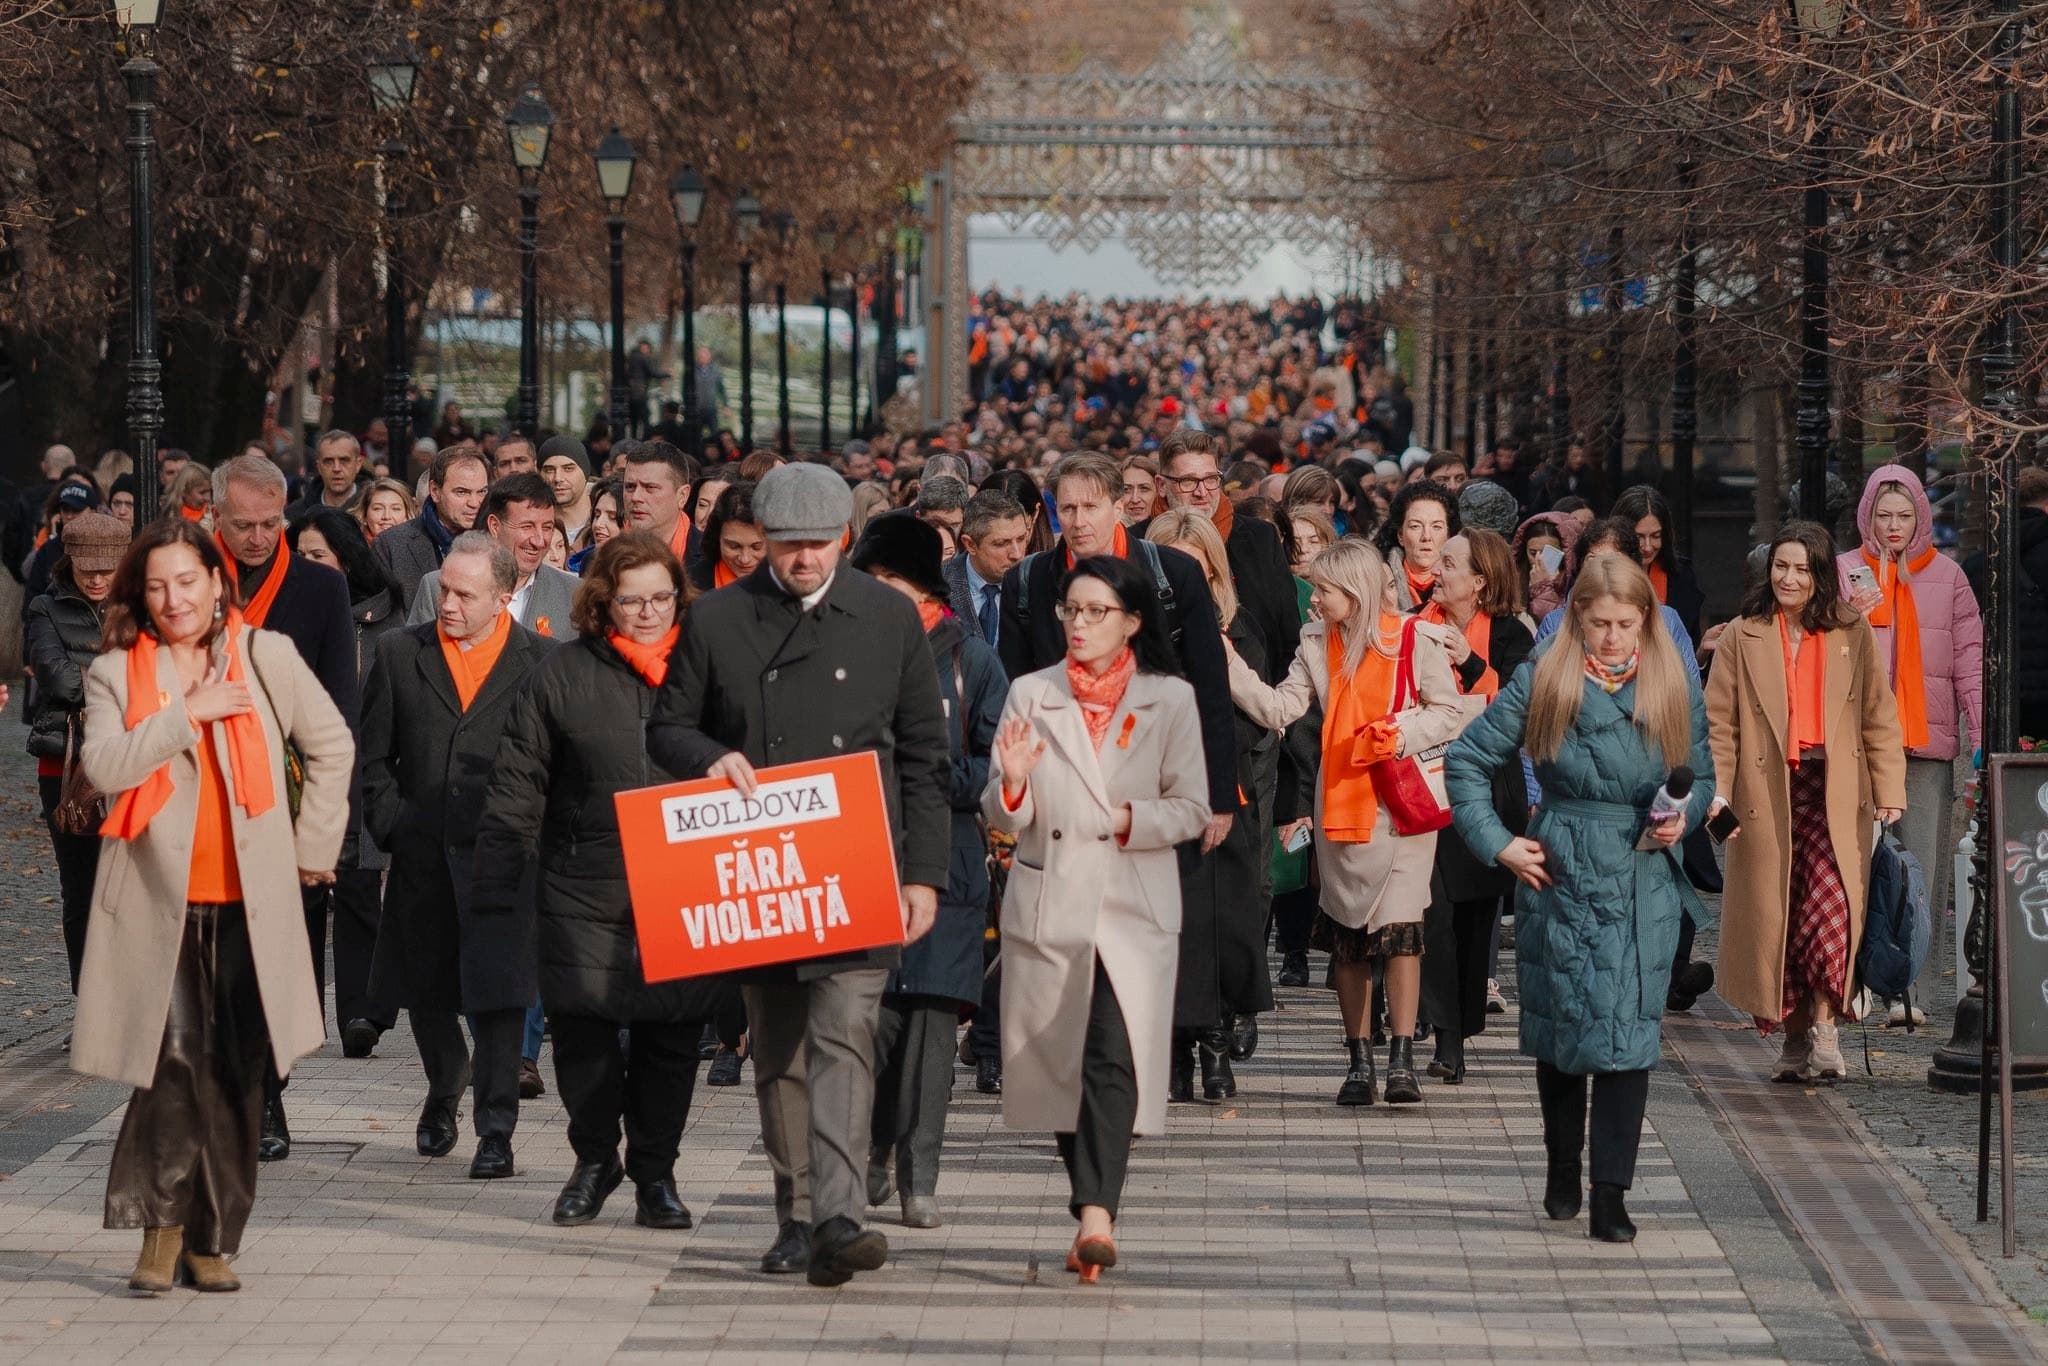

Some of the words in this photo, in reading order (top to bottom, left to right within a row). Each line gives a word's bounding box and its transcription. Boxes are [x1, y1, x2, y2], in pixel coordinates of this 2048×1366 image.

[673, 787, 828, 833] MOLDOVA
[714, 830, 807, 897] FĂRĂ
[680, 874, 850, 949] VIOLENȚĂ
